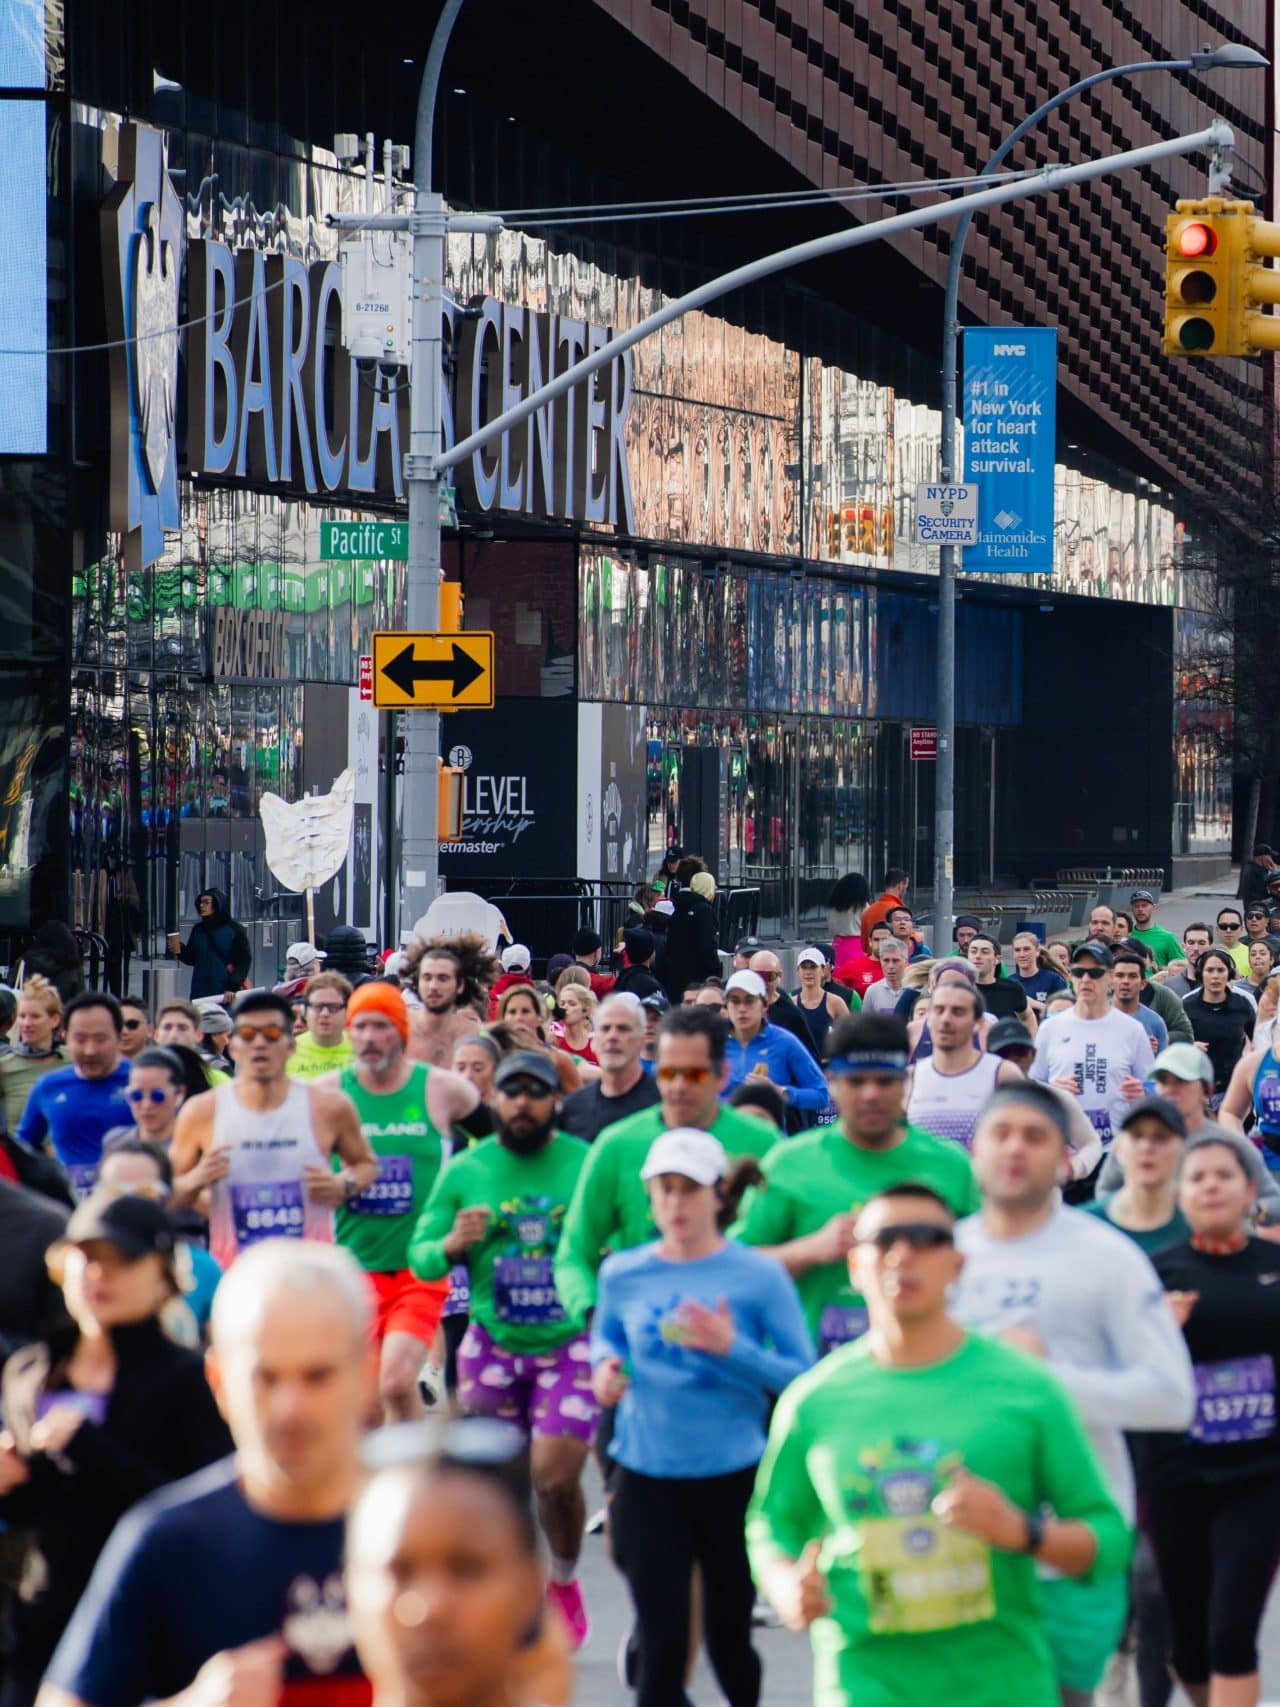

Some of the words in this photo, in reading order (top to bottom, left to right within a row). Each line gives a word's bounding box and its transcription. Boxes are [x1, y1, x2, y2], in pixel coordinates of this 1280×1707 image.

[993, 344, 1027, 356] NYC
[970, 381, 989, 396] #1
[994, 381, 1009, 396] in
[471, 294, 636, 535] CENTER
[970, 401, 1005, 415] New
[1008, 400, 1042, 415] York
[970, 419, 992, 434] for
[996, 419, 1037, 434] heart
[970, 439, 1019, 454] attack
[970, 458, 1035, 473] survival.
[926, 487, 969, 500] NYPD
[918, 515, 975, 529] SECURITY
[330, 526, 385, 555] Pacific
[391, 528, 401, 545] St
[920, 527, 972, 541] CAMERA
[986, 544, 1028, 558] Health
[215, 607, 243, 676] BOX
[246, 608, 290, 679] OFFICE
[463, 775, 535, 815] LEVEL
[462, 805, 536, 844] ership
[439, 841, 500, 853] etmaster
[1085, 1043, 1096, 1082] JUSTICE
[1096, 1058, 1107, 1093] CENTER
[360, 1182, 412, 1200] 2333
[1202, 1391, 1275, 1422] 13772
